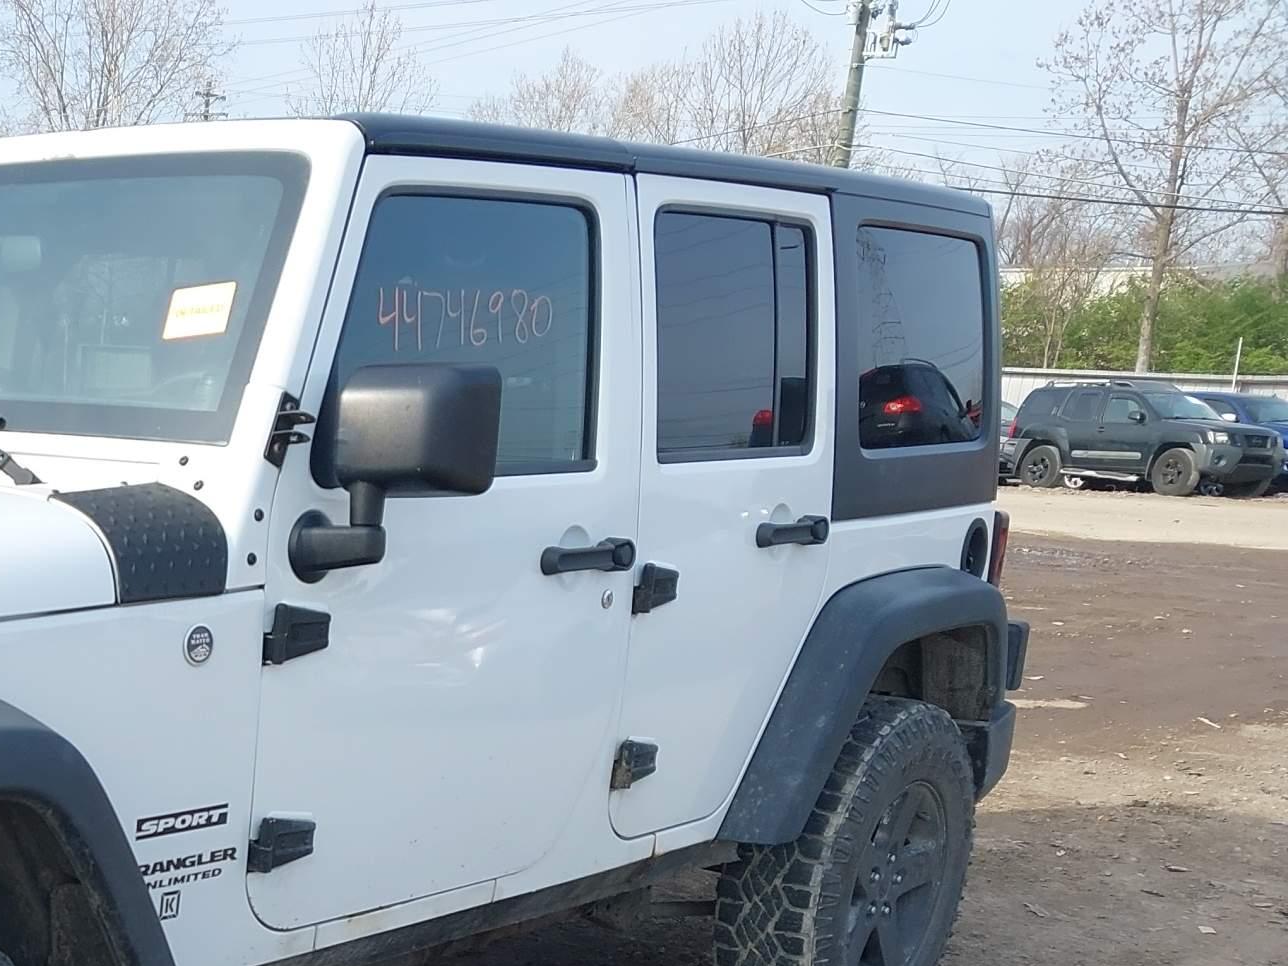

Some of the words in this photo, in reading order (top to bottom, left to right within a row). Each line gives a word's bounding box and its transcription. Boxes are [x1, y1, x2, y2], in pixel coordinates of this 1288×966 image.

[378, 287, 552, 351] 44746980
[136, 808, 228, 837] SPORT
[139, 847, 237, 876] RANGLER
[146, 868, 222, 889] NLIMITED
